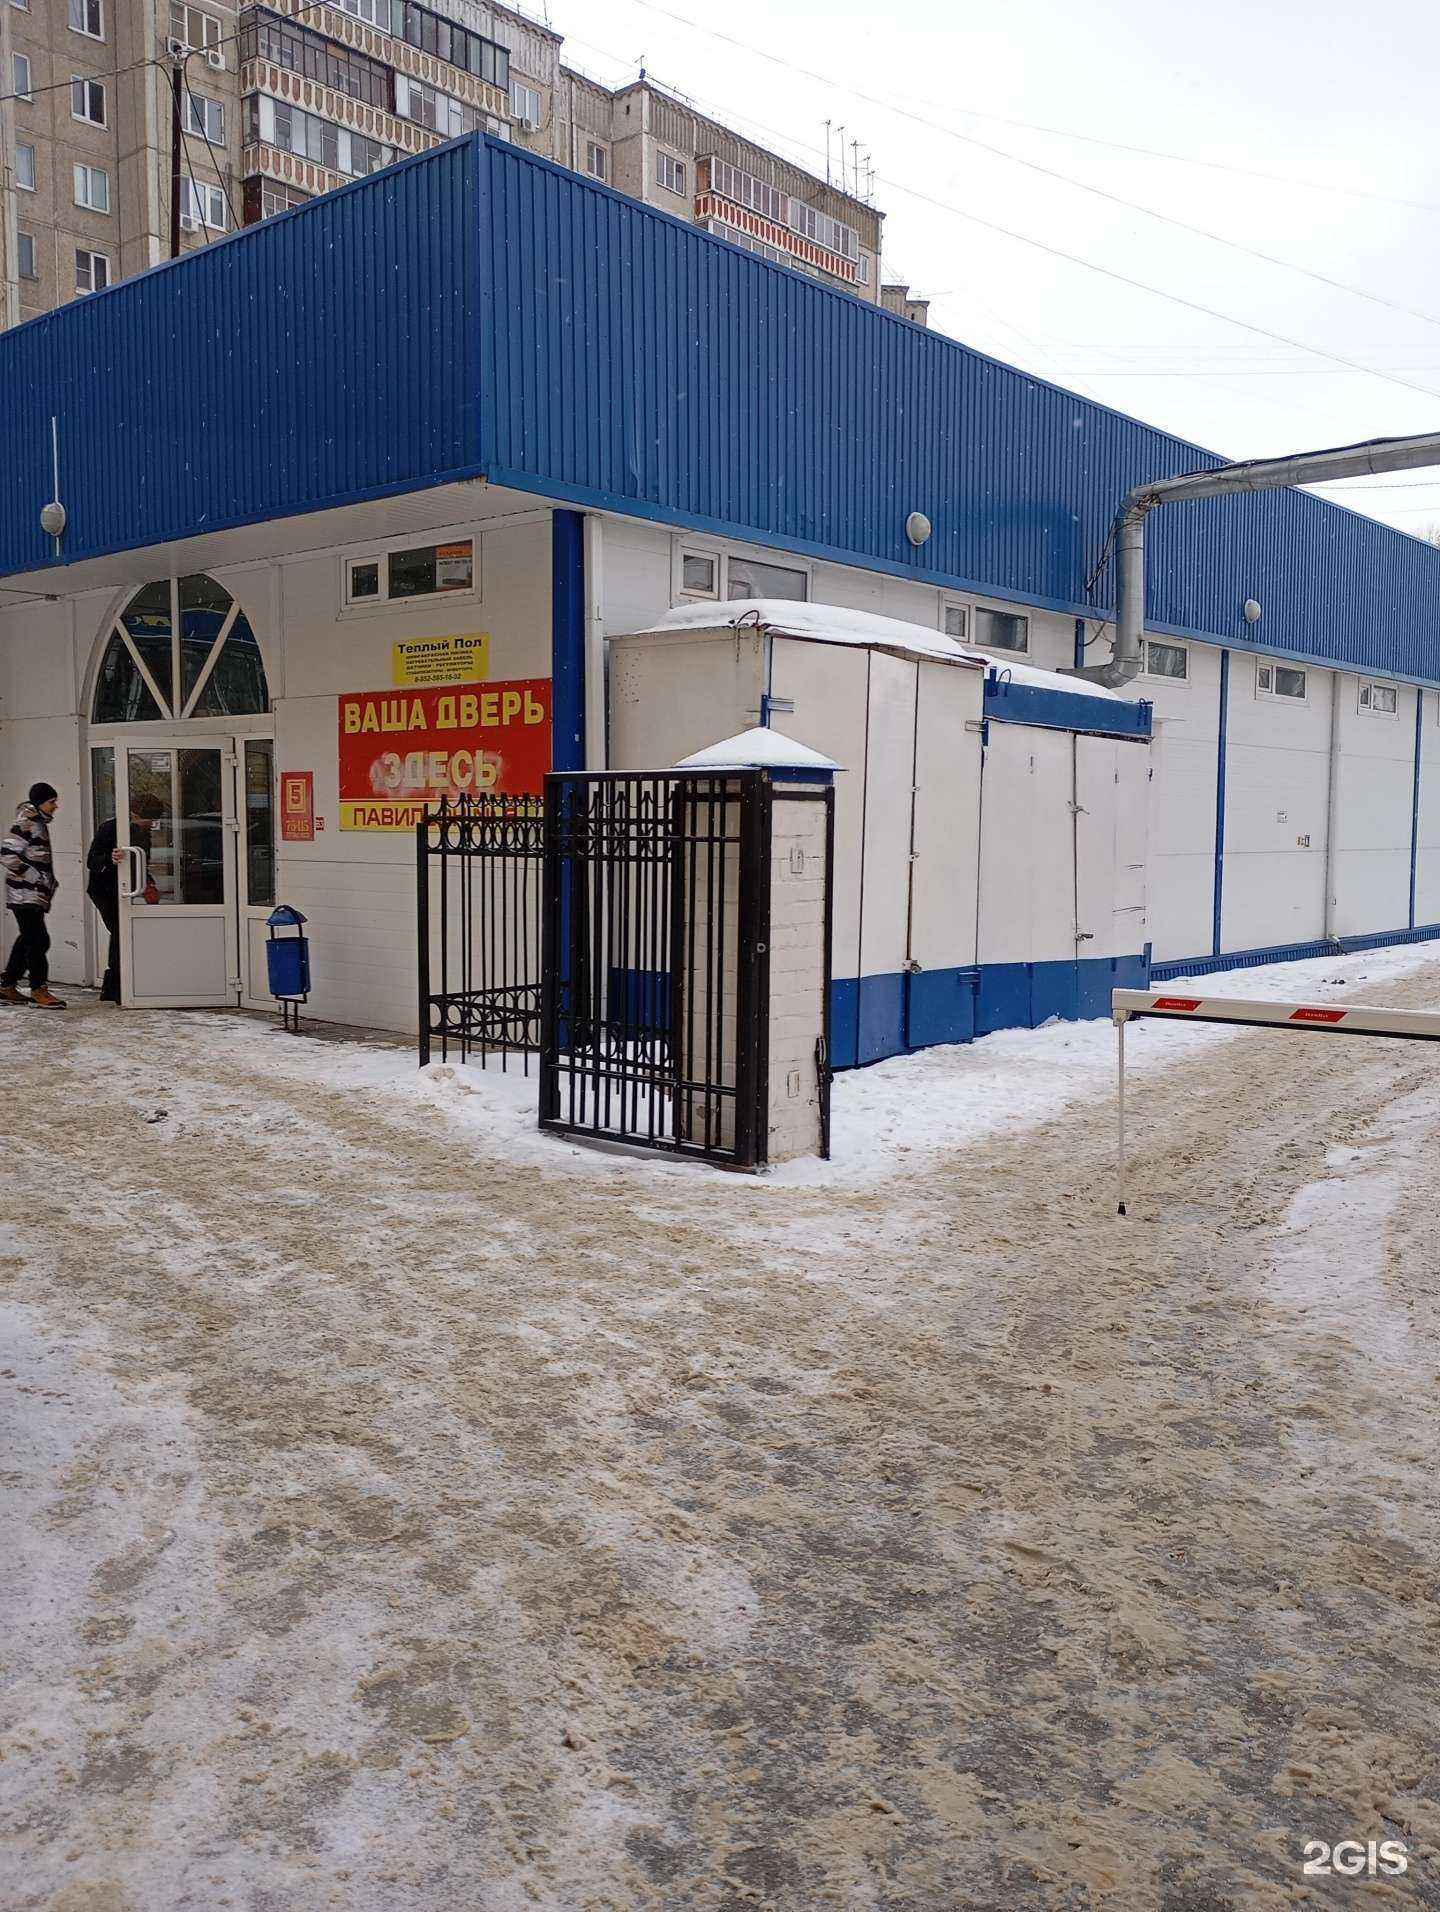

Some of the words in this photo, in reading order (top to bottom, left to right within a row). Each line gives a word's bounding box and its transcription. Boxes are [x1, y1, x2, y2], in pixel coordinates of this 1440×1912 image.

[398, 639, 450, 654] Теплый
[454, 638, 482, 649] Пол
[344, 698, 428, 734] ВАША
[436, 689, 545, 729] ДВЕРЬ
[382, 749, 498, 788] ЗДЕСЬ
